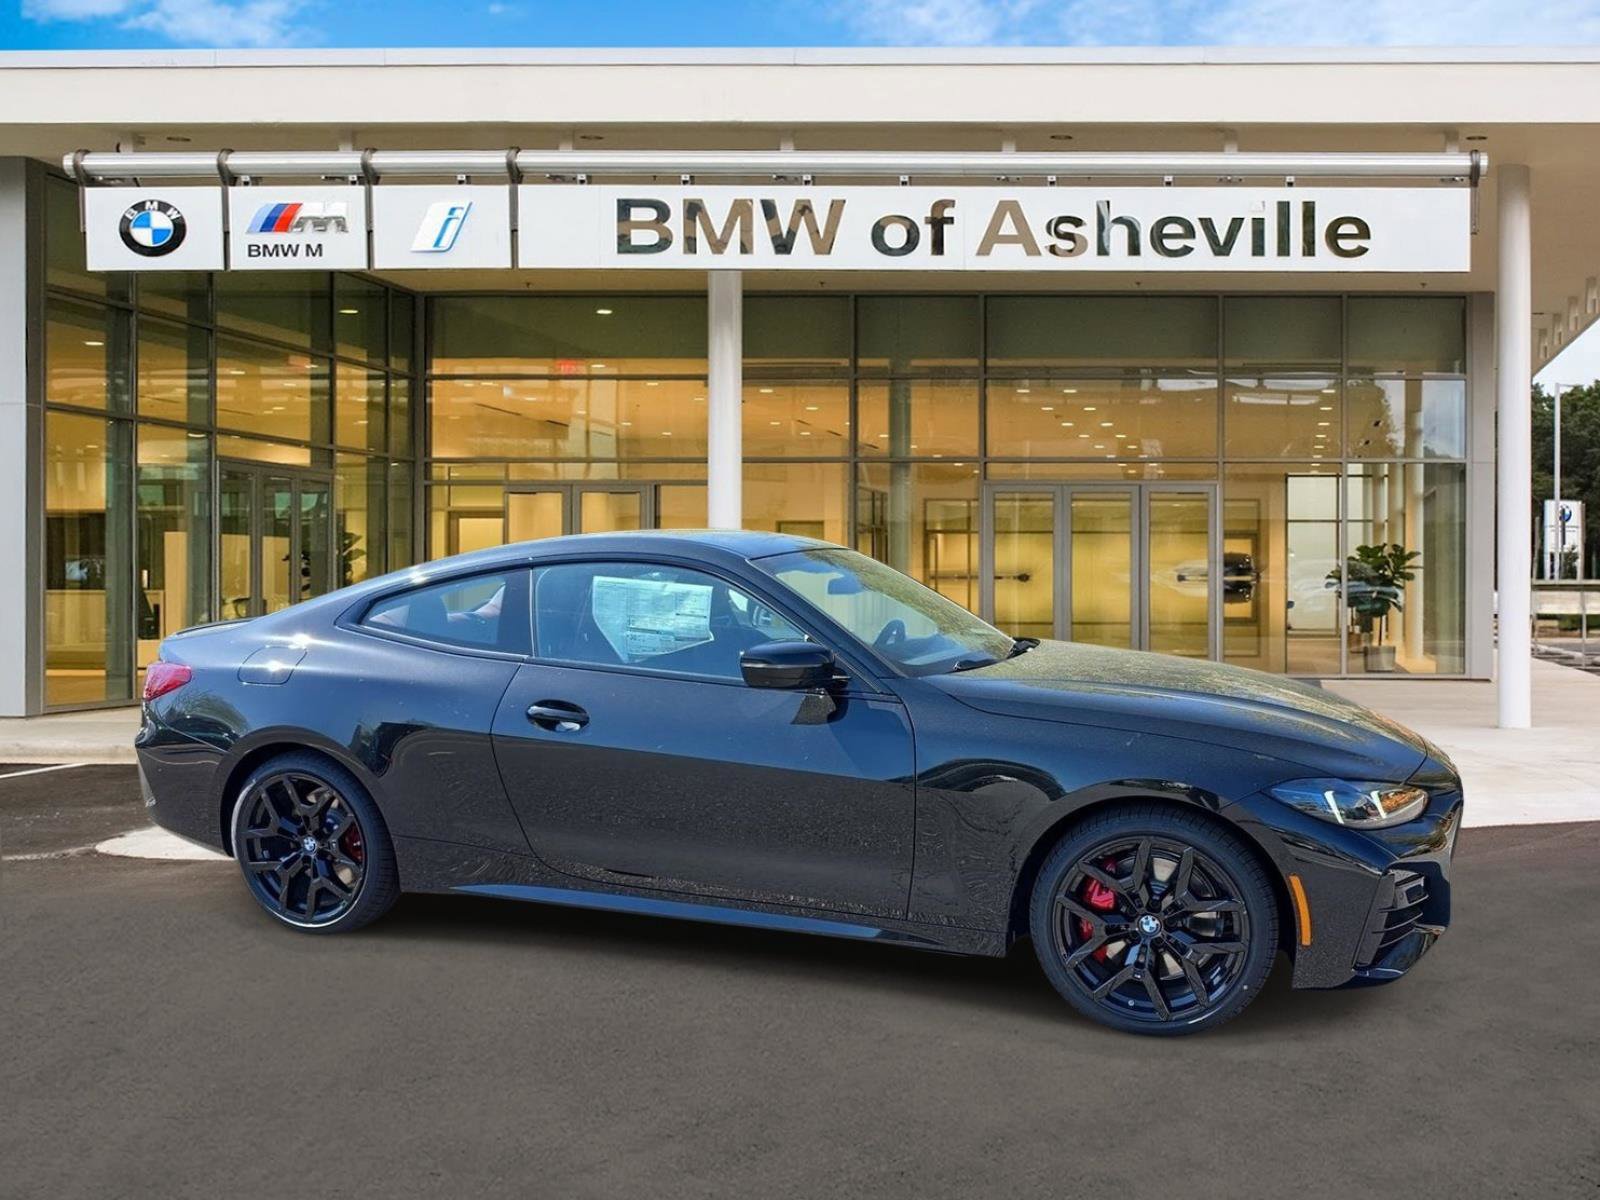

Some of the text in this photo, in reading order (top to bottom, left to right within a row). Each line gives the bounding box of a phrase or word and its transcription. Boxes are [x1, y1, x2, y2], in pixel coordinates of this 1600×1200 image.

[124, 200, 181, 220] BMW
[615, 198, 1372, 258] BMW of Asheville
[247, 243, 323, 258] BMW M
